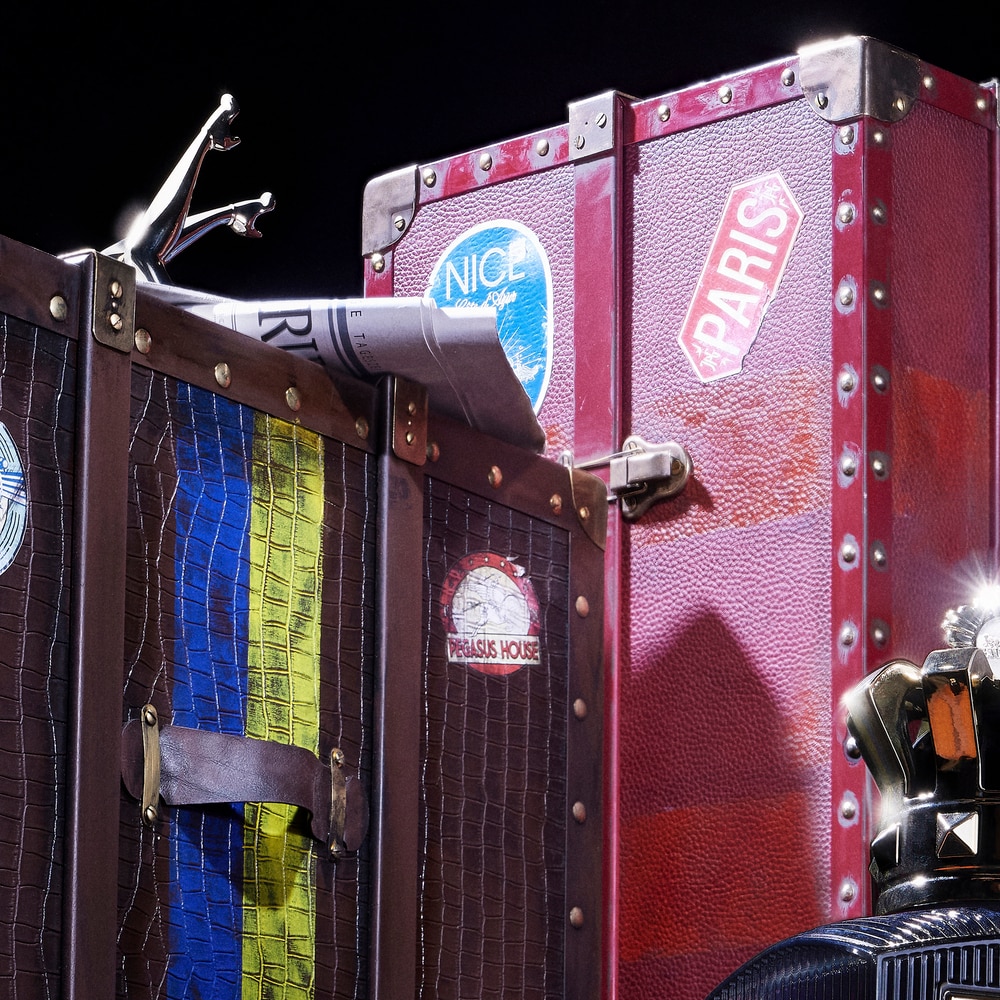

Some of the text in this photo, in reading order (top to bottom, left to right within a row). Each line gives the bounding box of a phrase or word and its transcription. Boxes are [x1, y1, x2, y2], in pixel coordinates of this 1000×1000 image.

[446, 238, 526, 300] NICE
[693, 198, 788, 356] PARIS
[449, 638, 539, 661] PEGASUS HOUSE
